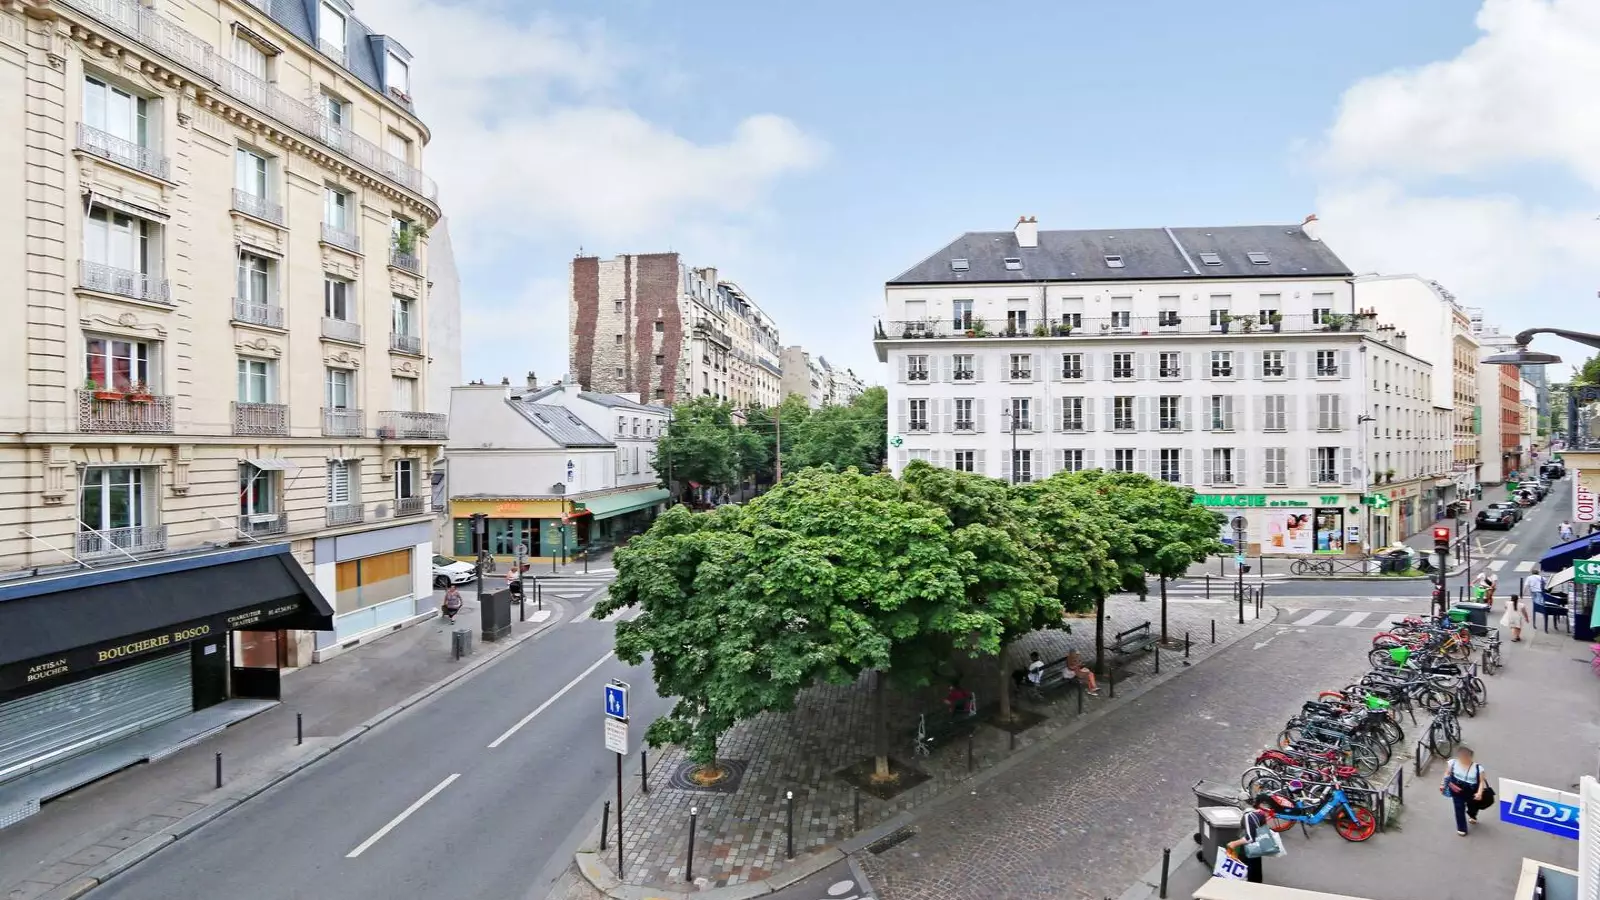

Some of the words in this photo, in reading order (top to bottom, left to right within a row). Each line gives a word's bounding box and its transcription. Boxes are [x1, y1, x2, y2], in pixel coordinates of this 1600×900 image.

[1320, 496, 1339, 505] 7/7
[97, 634, 170, 662] BOUCHERIE
[174, 624, 210, 642] BOSCO
[27, 666, 69, 682] BOUCHER
[29, 658, 67, 674] ARTISAN
[1518, 798, 1570, 823] FDJ
